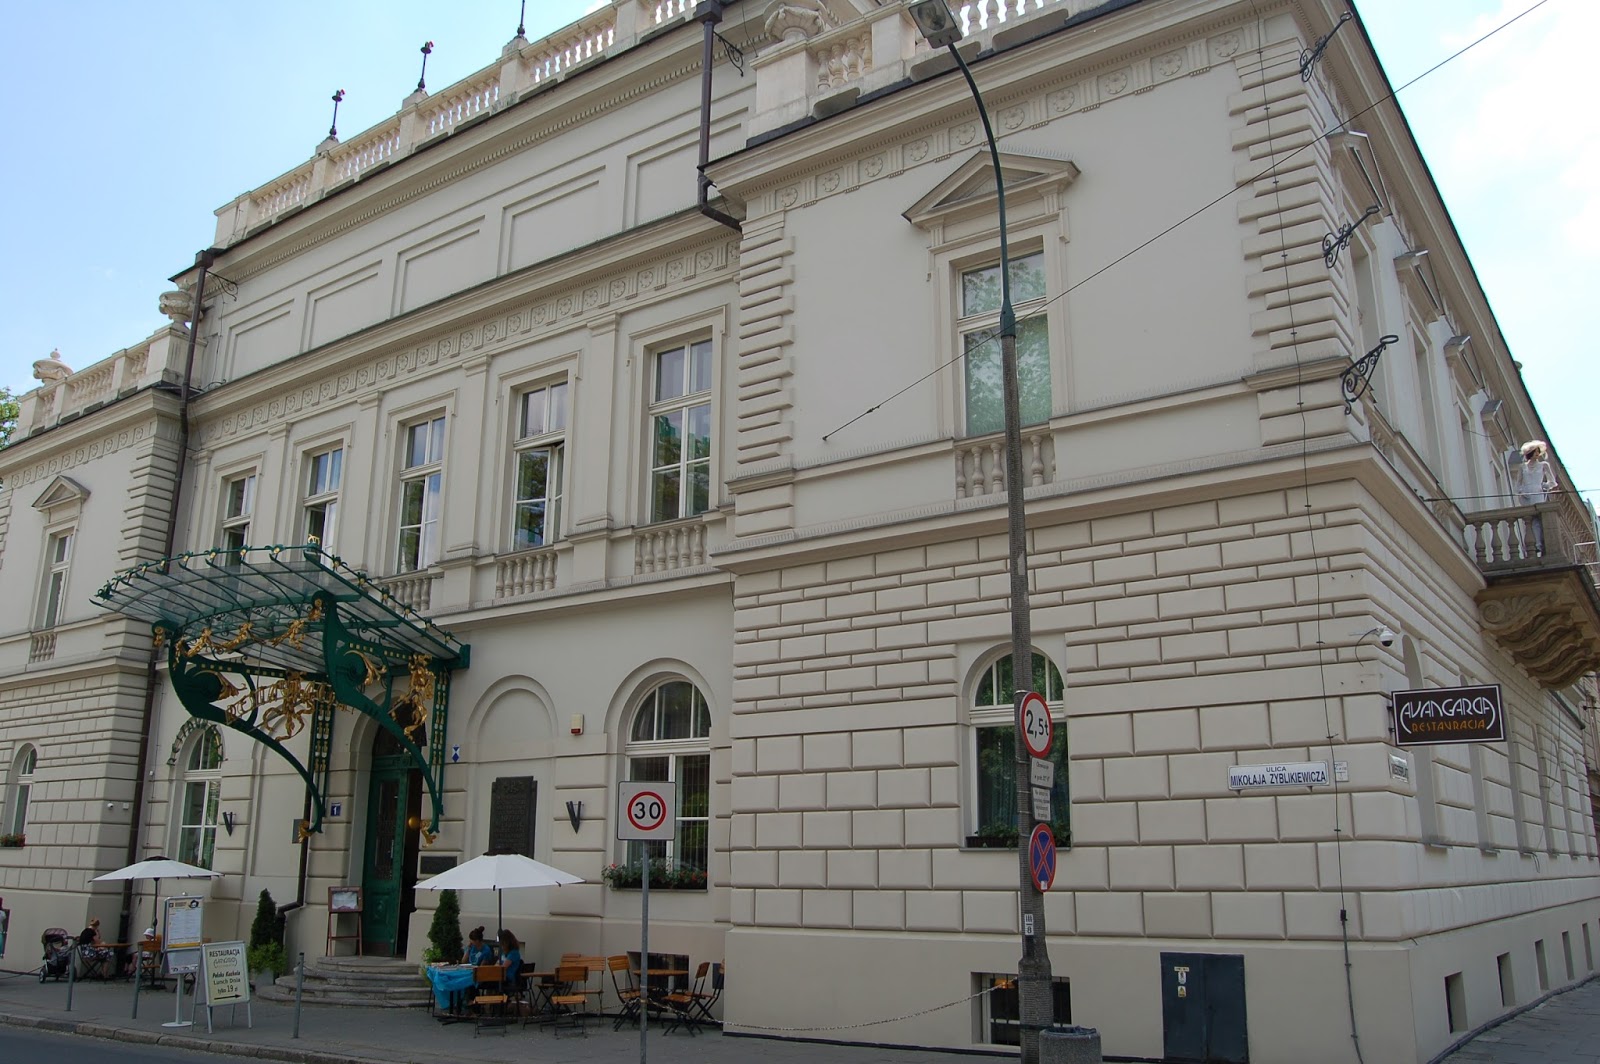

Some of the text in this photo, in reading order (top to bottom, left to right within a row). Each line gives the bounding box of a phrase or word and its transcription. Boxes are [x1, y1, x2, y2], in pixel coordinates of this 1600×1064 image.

[1026, 709, 1049, 738] 2,5t
[1230, 774, 1267, 786] MIKOŁAJA
[1270, 771, 1326, 784] ZYBLIKIEWICZA
[634, 801, 661, 819] 30
